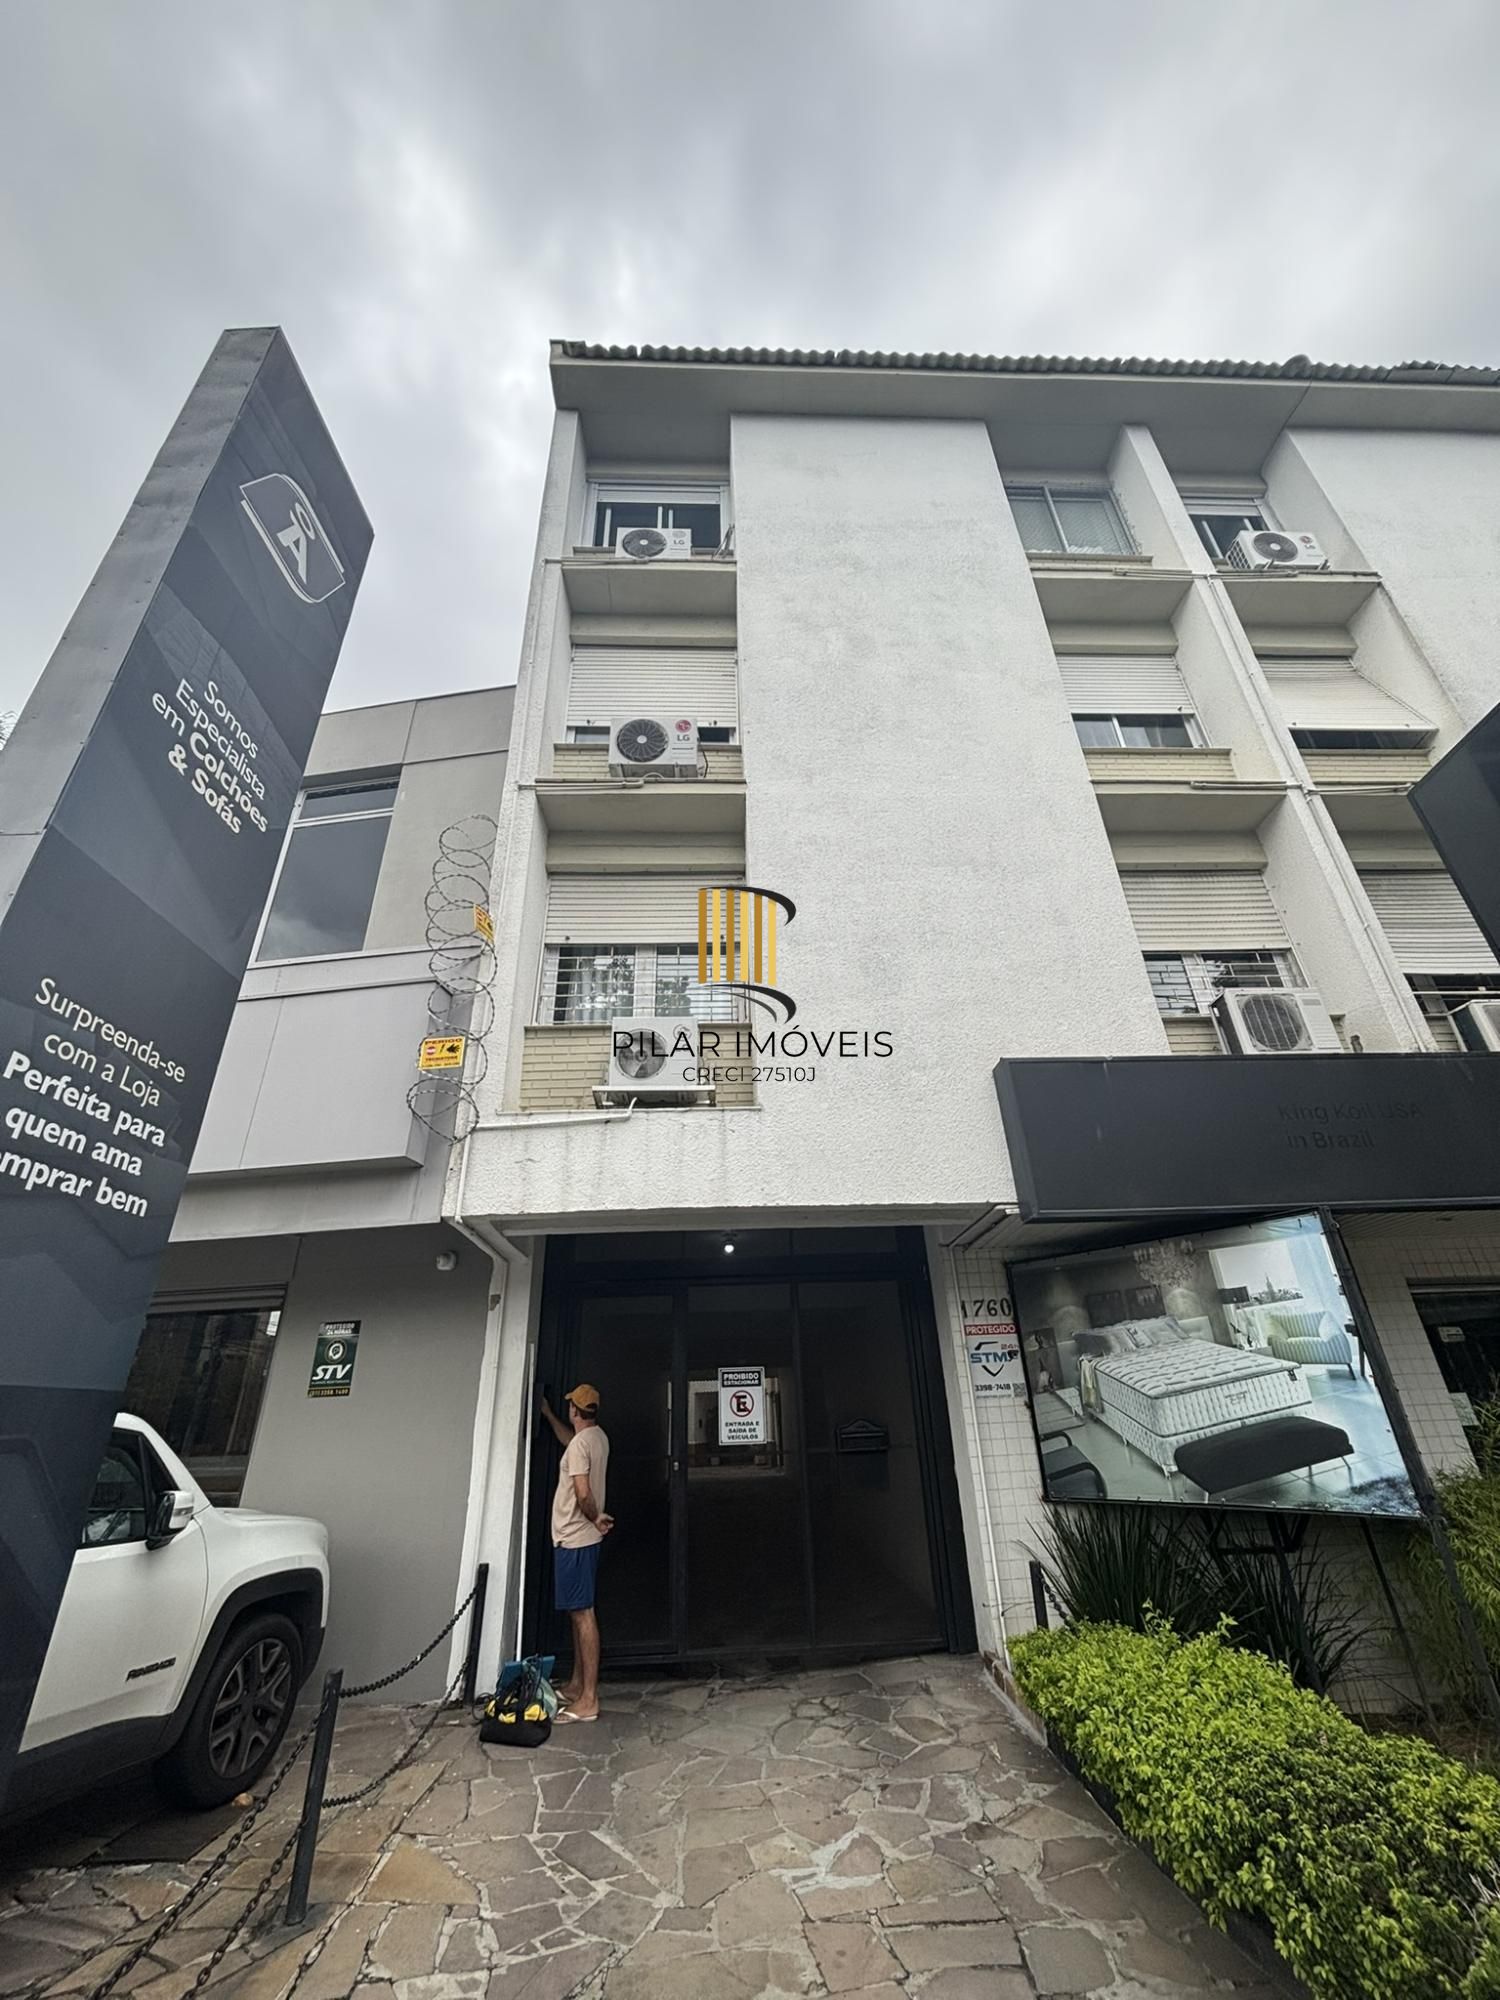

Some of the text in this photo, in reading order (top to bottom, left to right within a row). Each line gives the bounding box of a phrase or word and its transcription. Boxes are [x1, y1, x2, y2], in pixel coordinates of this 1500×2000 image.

[176, 678, 265, 800] Especialista
[204, 680, 259, 759] Somos
[152, 692, 268, 832] em Colchões
[168, 743, 242, 834] & Sofás
[35, 977, 186, 1083] Surpreenda-se
[2, 1050, 165, 1147] Perfeita para
[44, 1034, 160, 1108] com a Loja
[5, 1106, 142, 1176] quem ama
[1277, 1103, 1329, 1124] King
[1312, 1129, 1375, 1149] Brazil
[0, 1150, 148, 1217] mprar bem
[961, 1298, 1012, 1318] 1760
[966, 1324, 1016, 1334] PROTEGIDO
[311, 1363, 352, 1380] STV
[723, 1372, 760, 1380] PROIBIDO
